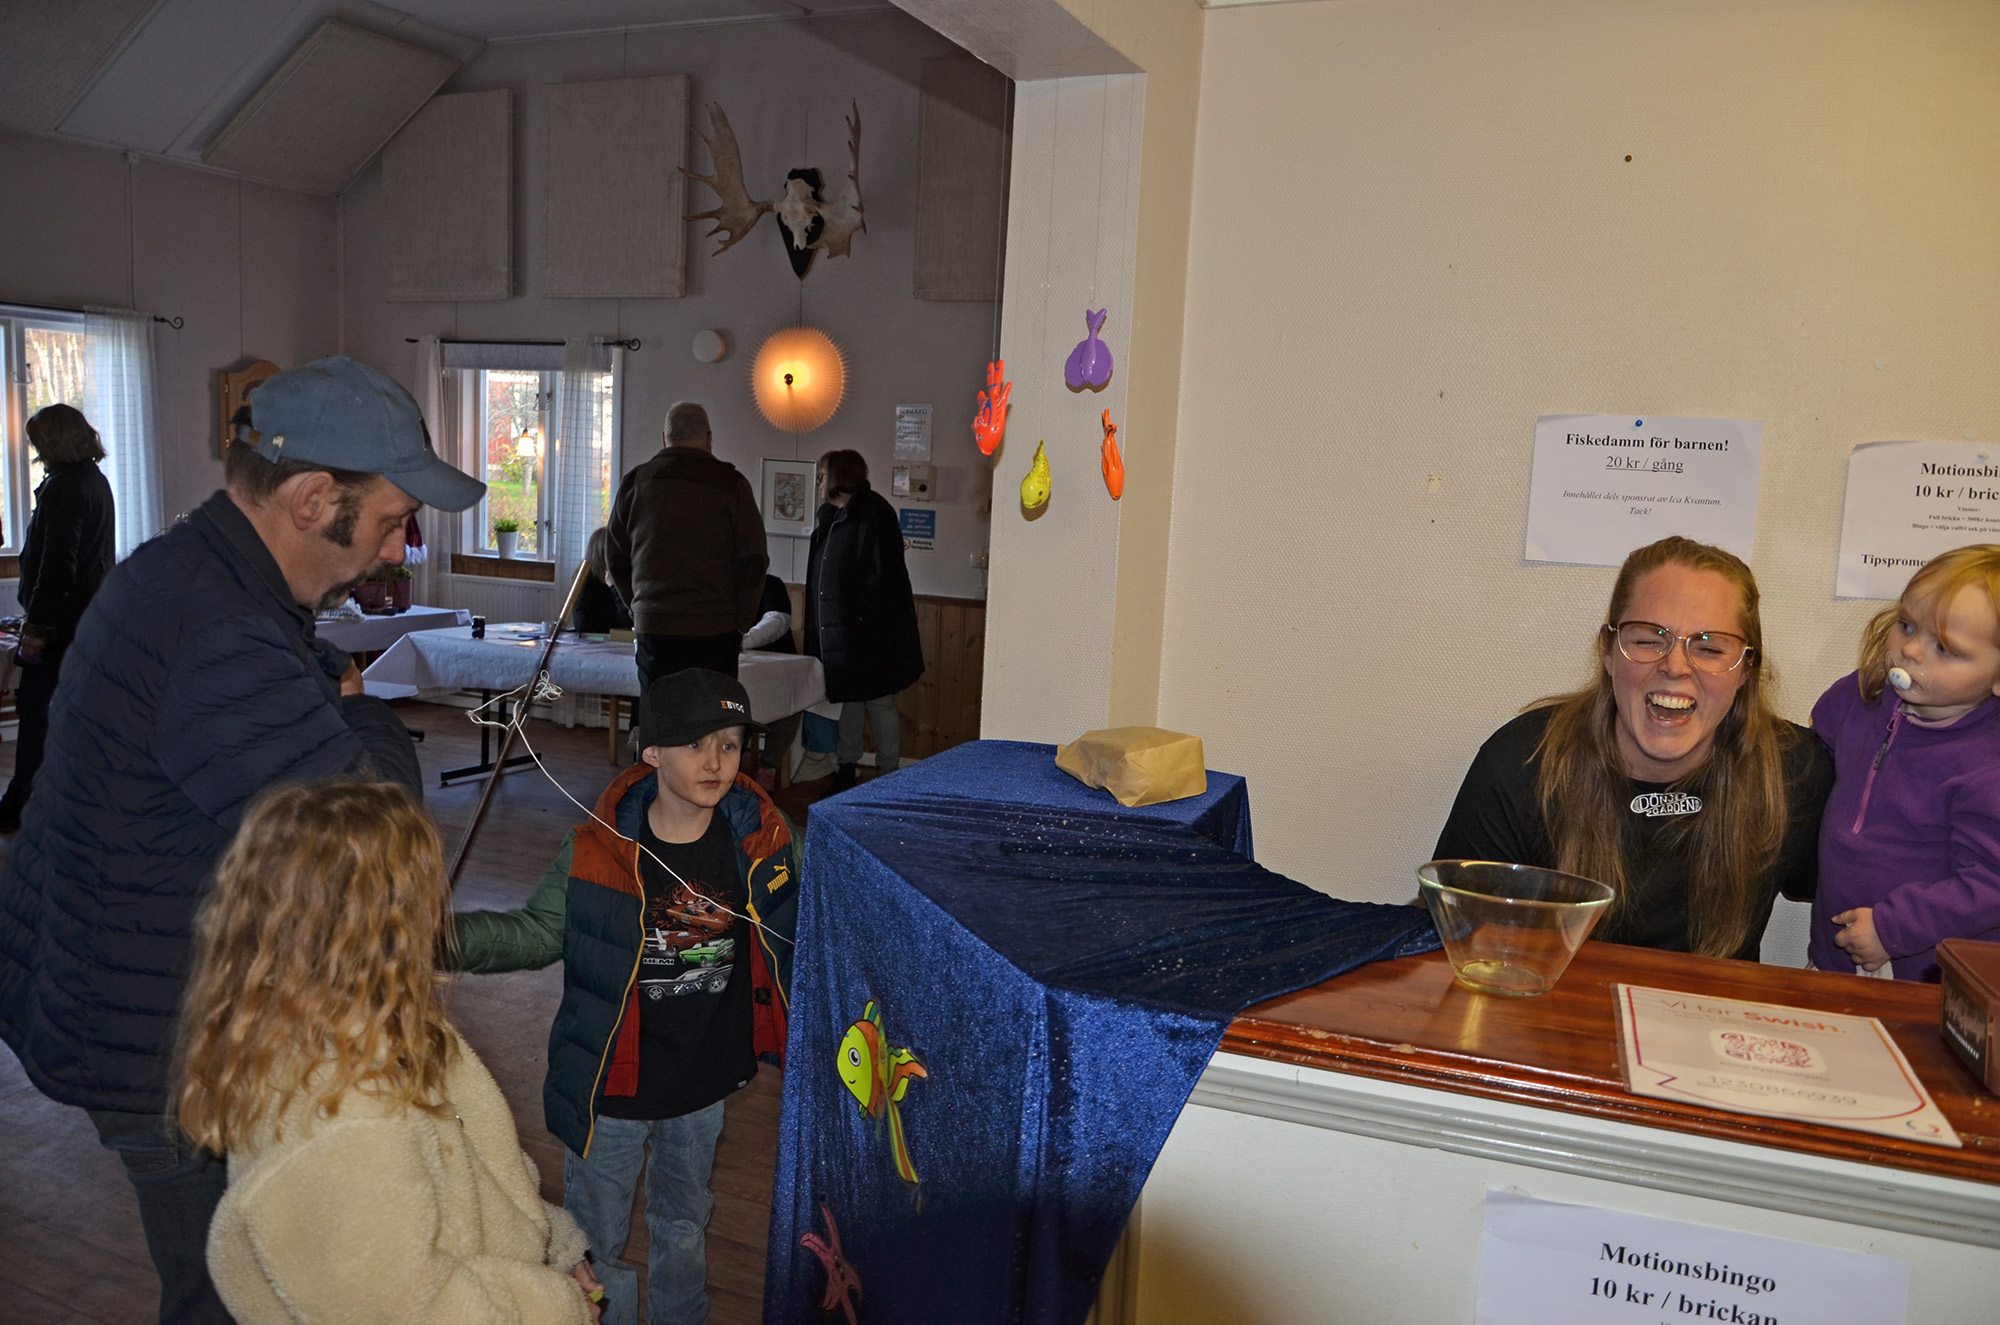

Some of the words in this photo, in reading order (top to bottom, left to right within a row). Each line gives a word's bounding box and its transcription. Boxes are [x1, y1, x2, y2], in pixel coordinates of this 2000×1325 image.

[1566, 433, 1645, 448] Fiskedamm
[1650, 436, 1670, 449] för
[1674, 438, 1729, 451] barnen!
[1606, 456, 1622, 468] 20
[1626, 457, 1640, 469] kr
[1643, 457, 1649, 469] /
[1652, 458, 1684, 474] gång
[1920, 462, 2000, 478] Motionsbi
[1563, 490, 1602, 500] Innehållet
[1603, 492, 1619, 500] dels
[1621, 494, 1656, 503] sponsrat
[1669, 495, 1682, 504] Ica
[1684, 496, 1723, 506] Kvantum.
[1915, 485, 1932, 497] 10
[1936, 486, 1954, 498] kr
[1957, 486, 1965, 499] /
[1629, 507, 1652, 516] Tack!
[1861, 553, 1929, 568] Tipsprome
[1599, 1241, 1777, 1295] Motionsbingo
[1589, 1276, 1617, 1299] 10
[1625, 1283, 1655, 1306] kr
[1660, 1291, 1672, 1309] /
[1678, 1294, 1778, 1325] brickan
